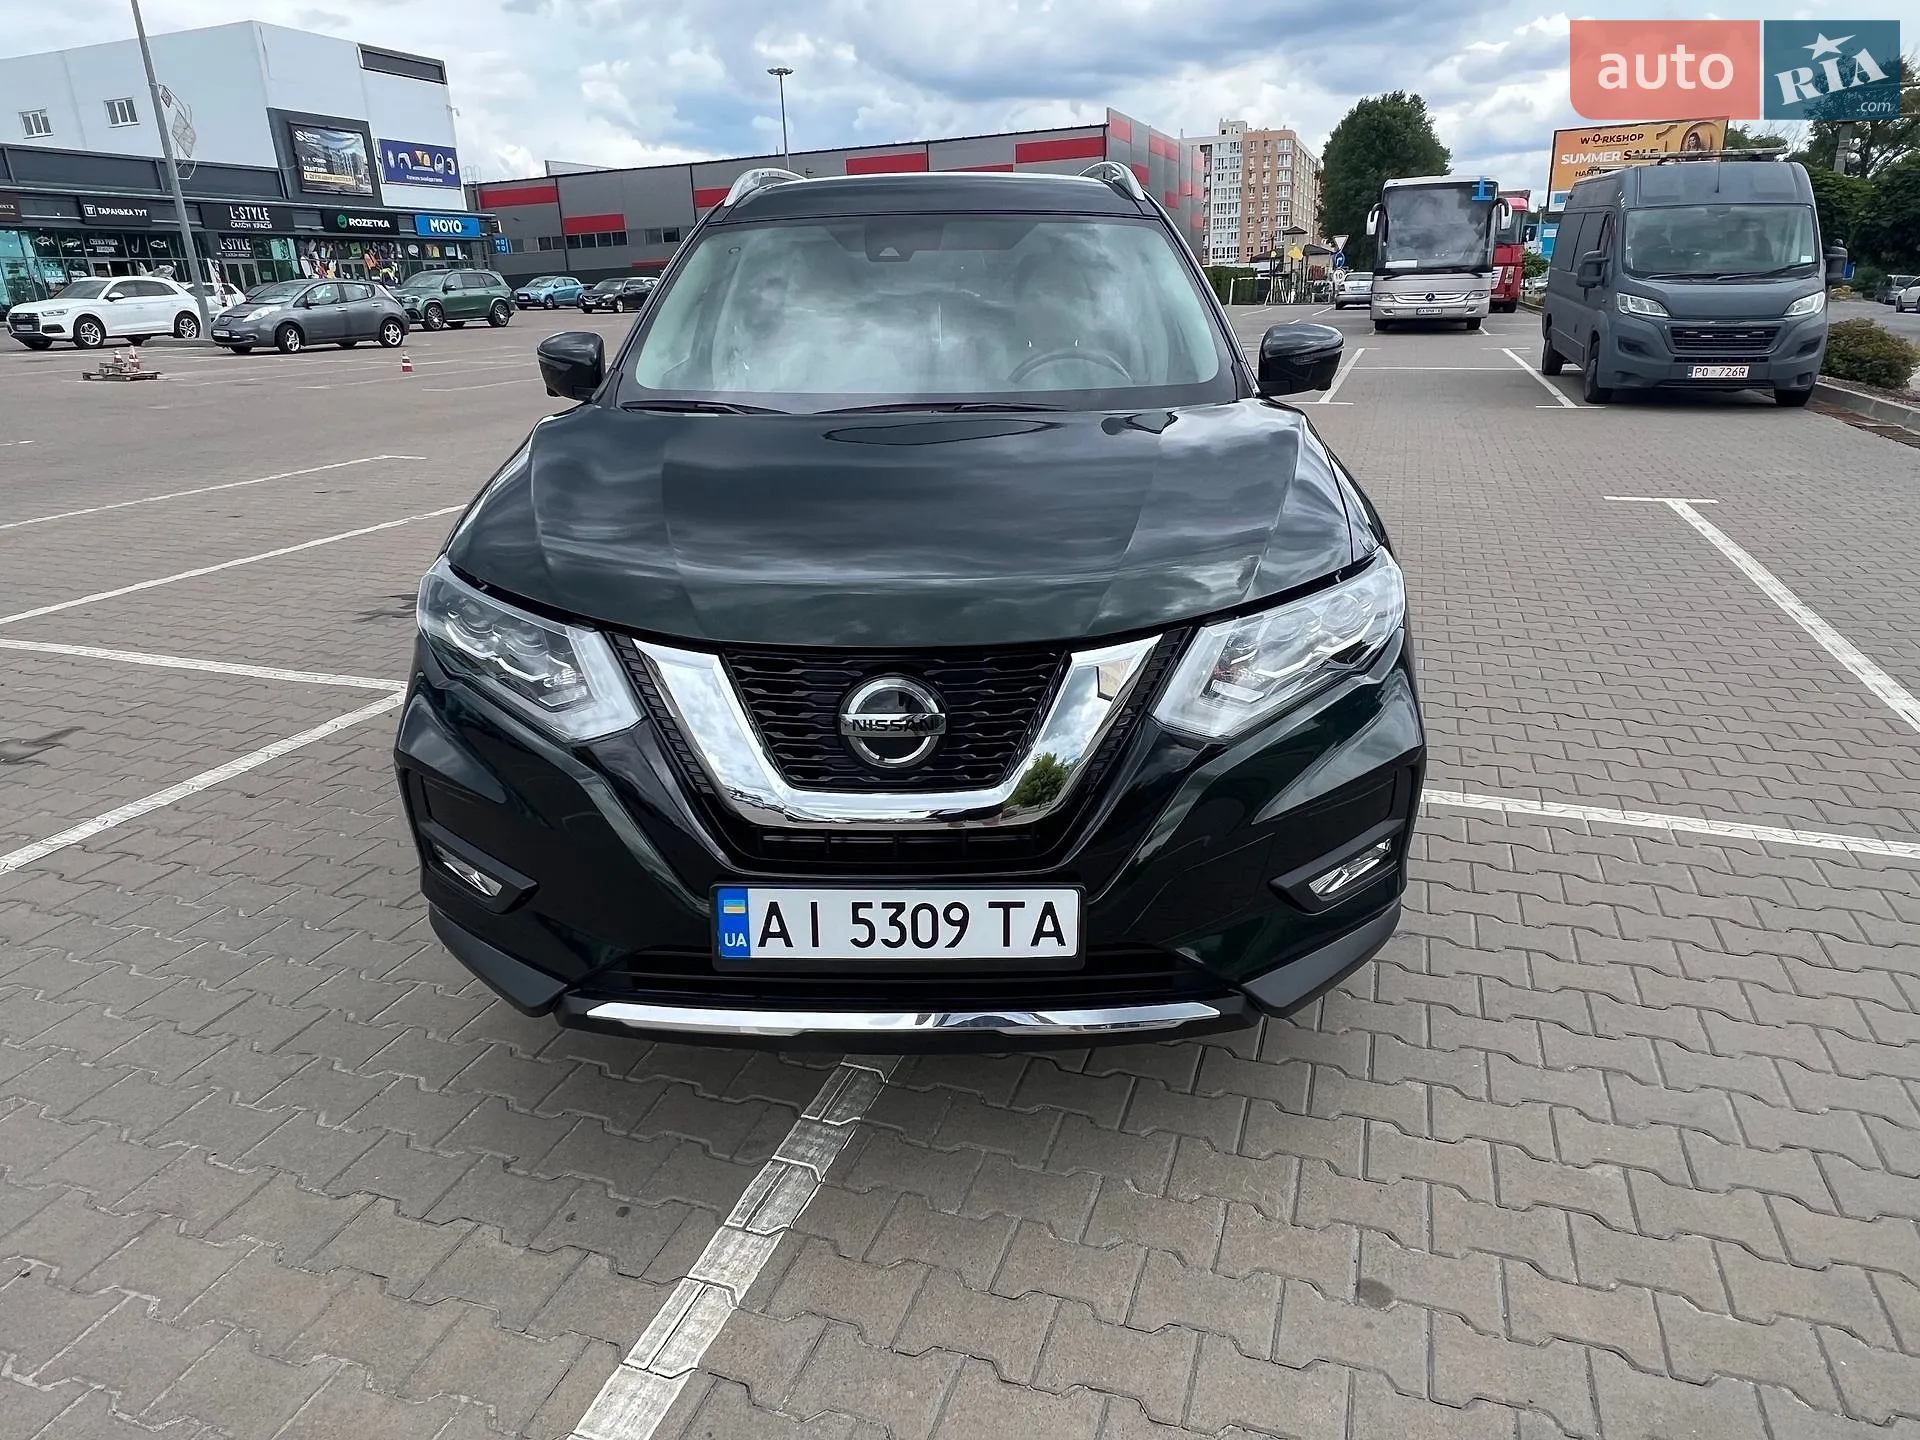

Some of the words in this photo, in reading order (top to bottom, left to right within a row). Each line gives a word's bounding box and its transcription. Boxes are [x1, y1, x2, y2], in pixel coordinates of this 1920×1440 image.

[1561, 151, 1621, 165] SUMMER
[229, 205, 271, 221] L-STYLE
[348, 217, 391, 229] ROZETKA
[429, 218, 463, 234] MOYO
[219, 238, 252, 251] L-STYLE
[1718, 367, 1746, 377] 726R
[851, 718, 935, 732] NISSAN
[757, 901, 820, 948] AI
[849, 901, 970, 949] 5309
[987, 901, 1067, 948] TA
[724, 932, 747, 947] UA
